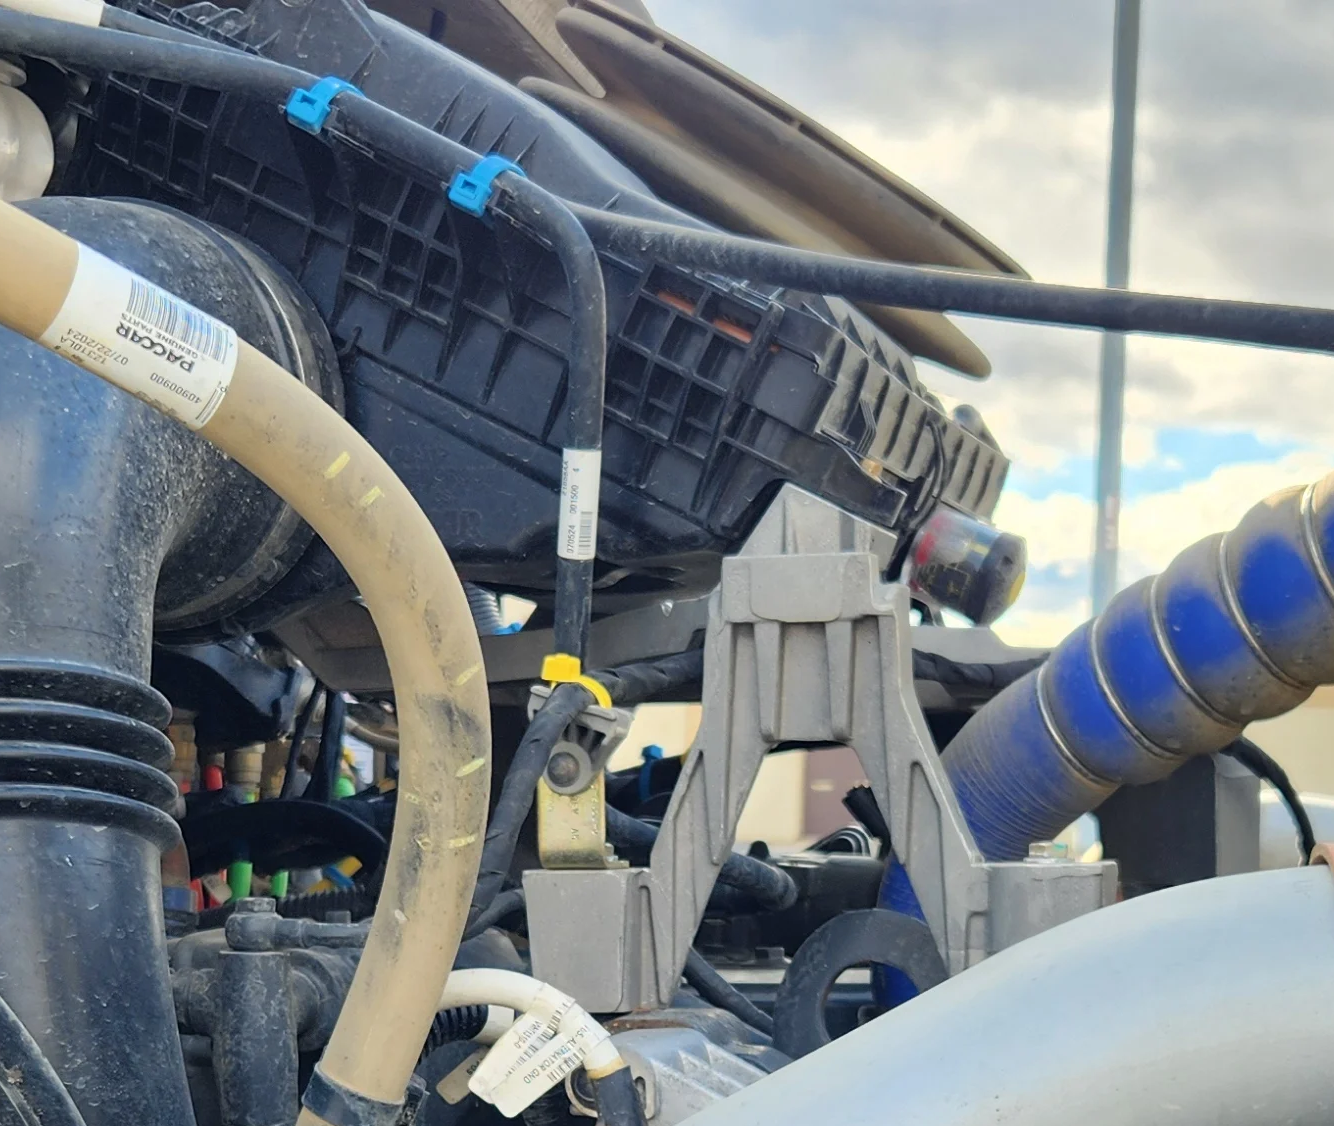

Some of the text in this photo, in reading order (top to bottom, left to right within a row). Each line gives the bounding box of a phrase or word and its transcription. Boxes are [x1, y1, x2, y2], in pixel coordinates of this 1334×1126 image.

[115, 321, 195, 374] PACCAR
[122, 313, 199, 360] GENUINE PARTS
